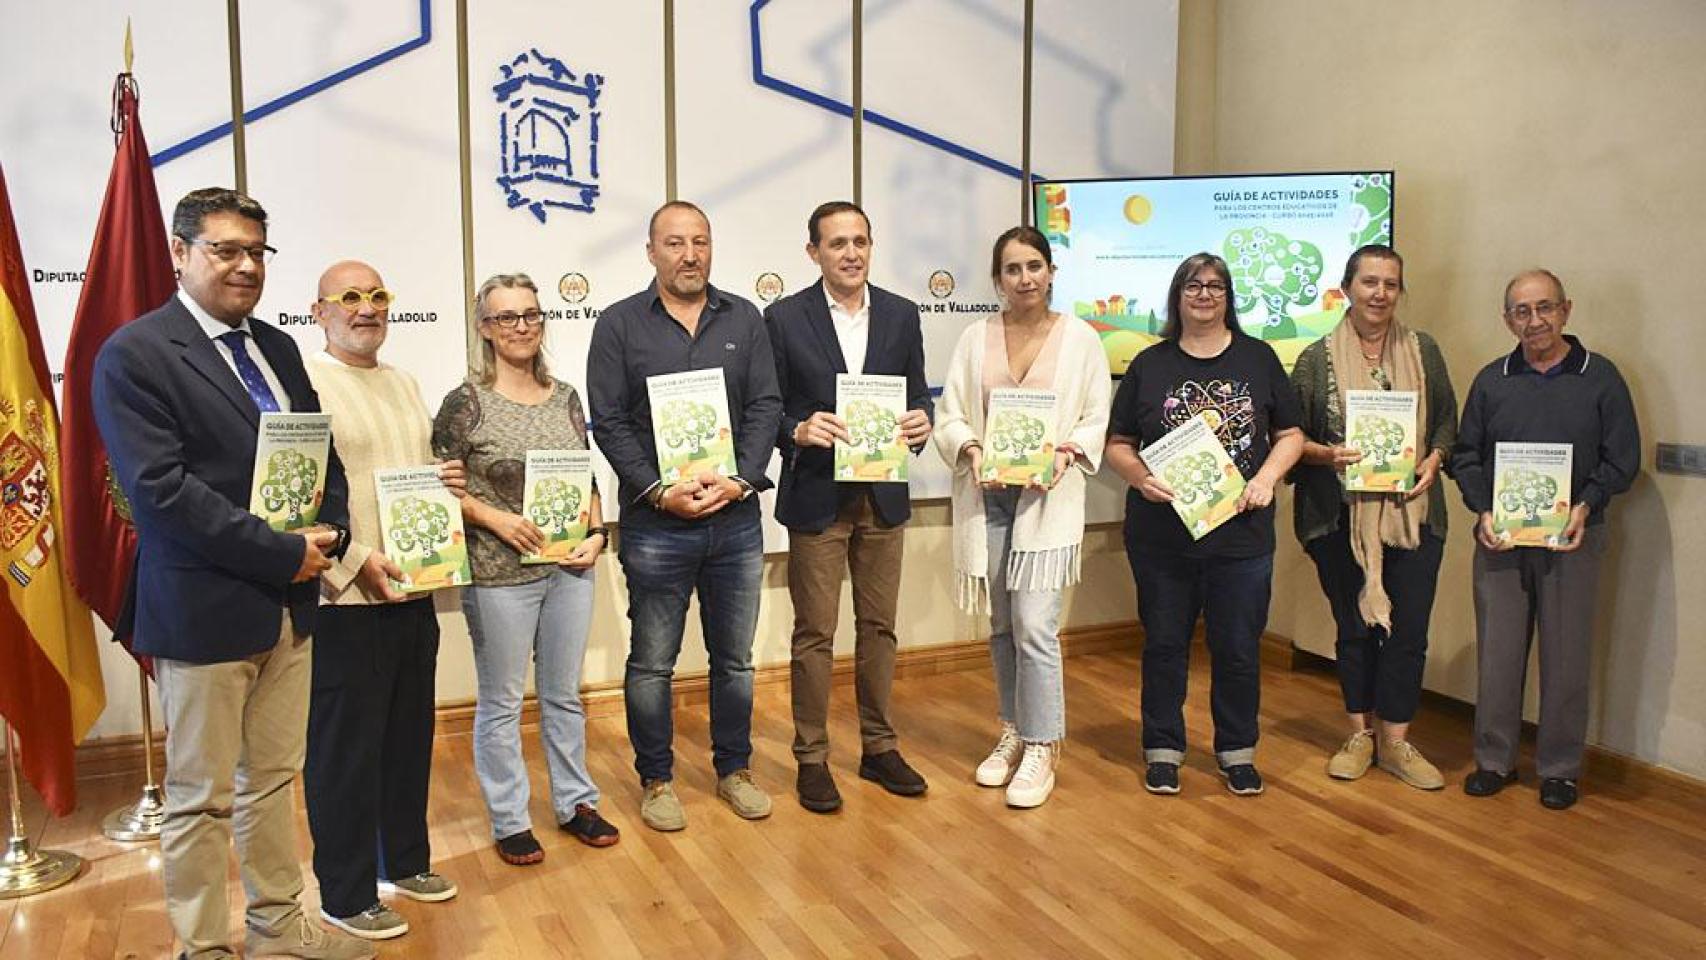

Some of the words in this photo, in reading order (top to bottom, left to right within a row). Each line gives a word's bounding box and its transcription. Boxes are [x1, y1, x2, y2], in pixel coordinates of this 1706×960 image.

[1213, 190, 1241, 202] GUÍA
[1244, 191, 1259, 201] DE
[1261, 189, 1339, 201] ACTIVIDADES
[33, 269, 86, 283] DIPUTAC
[934, 304, 945, 313] DE
[949, 301, 999, 313] VALLADOLID
[566, 309, 580, 319] DE
